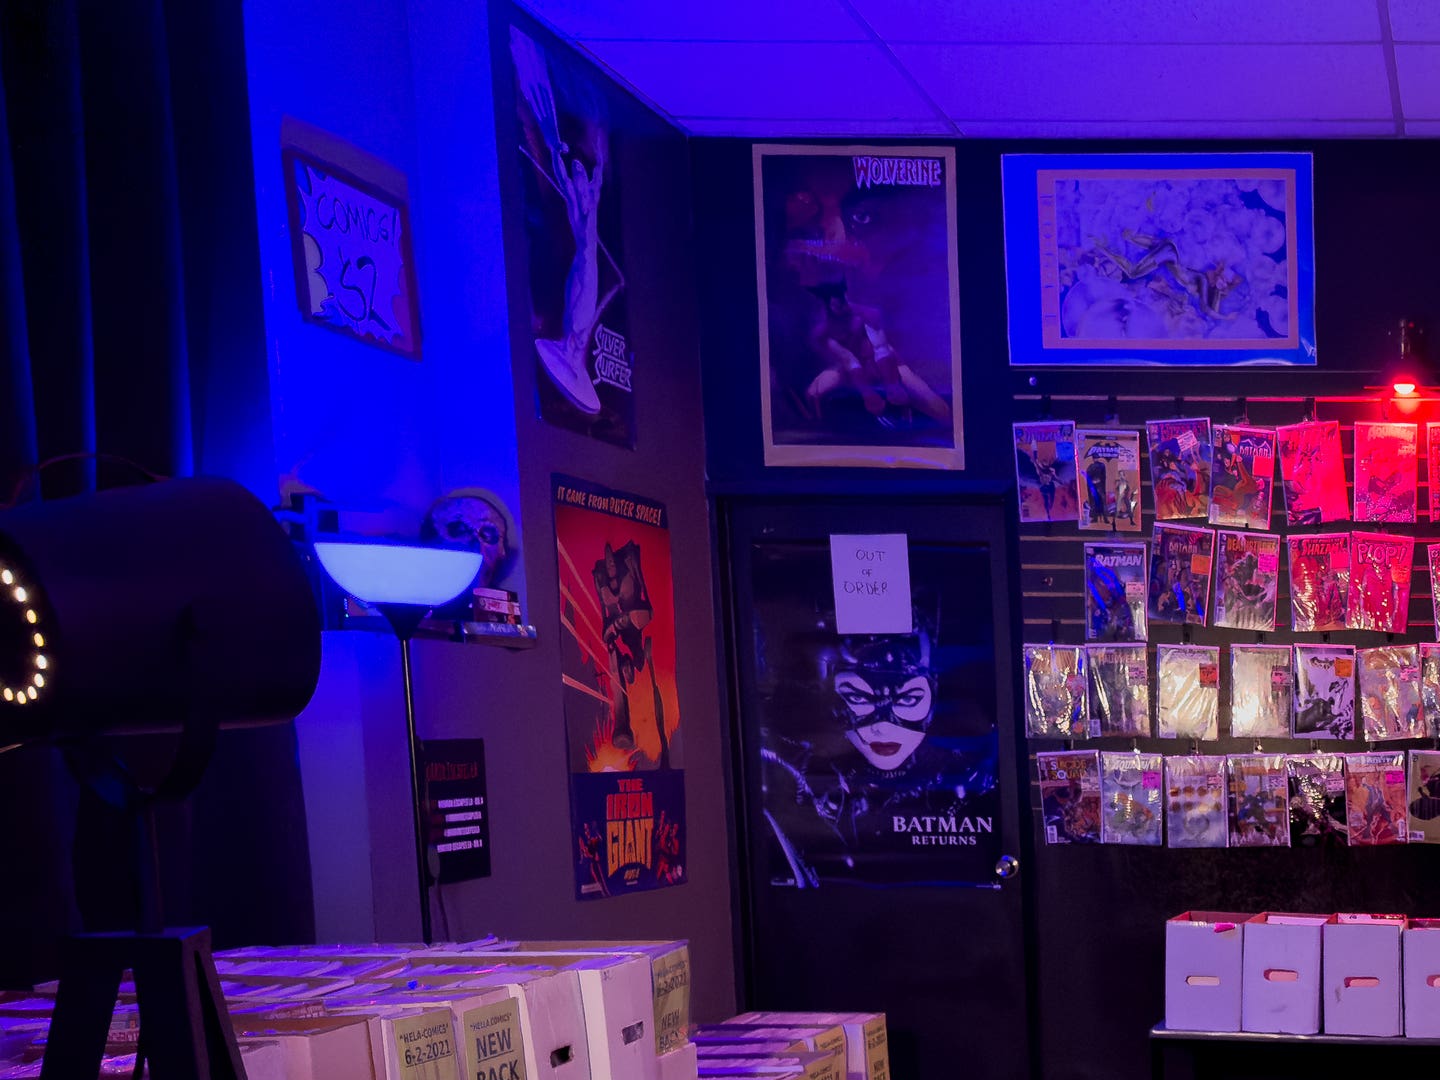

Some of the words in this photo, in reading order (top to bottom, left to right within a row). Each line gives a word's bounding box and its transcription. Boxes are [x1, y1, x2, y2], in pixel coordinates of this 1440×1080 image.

[852, 156, 942, 188] WOLVERINE
[557, 486, 567, 500] IT
[567, 489, 586, 506] CAME
[588, 493, 609, 510] FROM
[636, 504, 662, 526] SPACE!
[855, 549, 886, 562] OUT
[1094, 553, 1143, 567] BATMAN
[843, 581, 889, 596] ORDER
[617, 778, 644, 792] THE
[606, 792, 653, 820] IRON
[892, 815, 993, 834] BATMAN
[606, 818, 654, 877] GIANT
[911, 835, 977, 846] RETURNS
[405, 1039, 452, 1066] 6-2-2021
[475, 1028, 513, 1060] NEW
